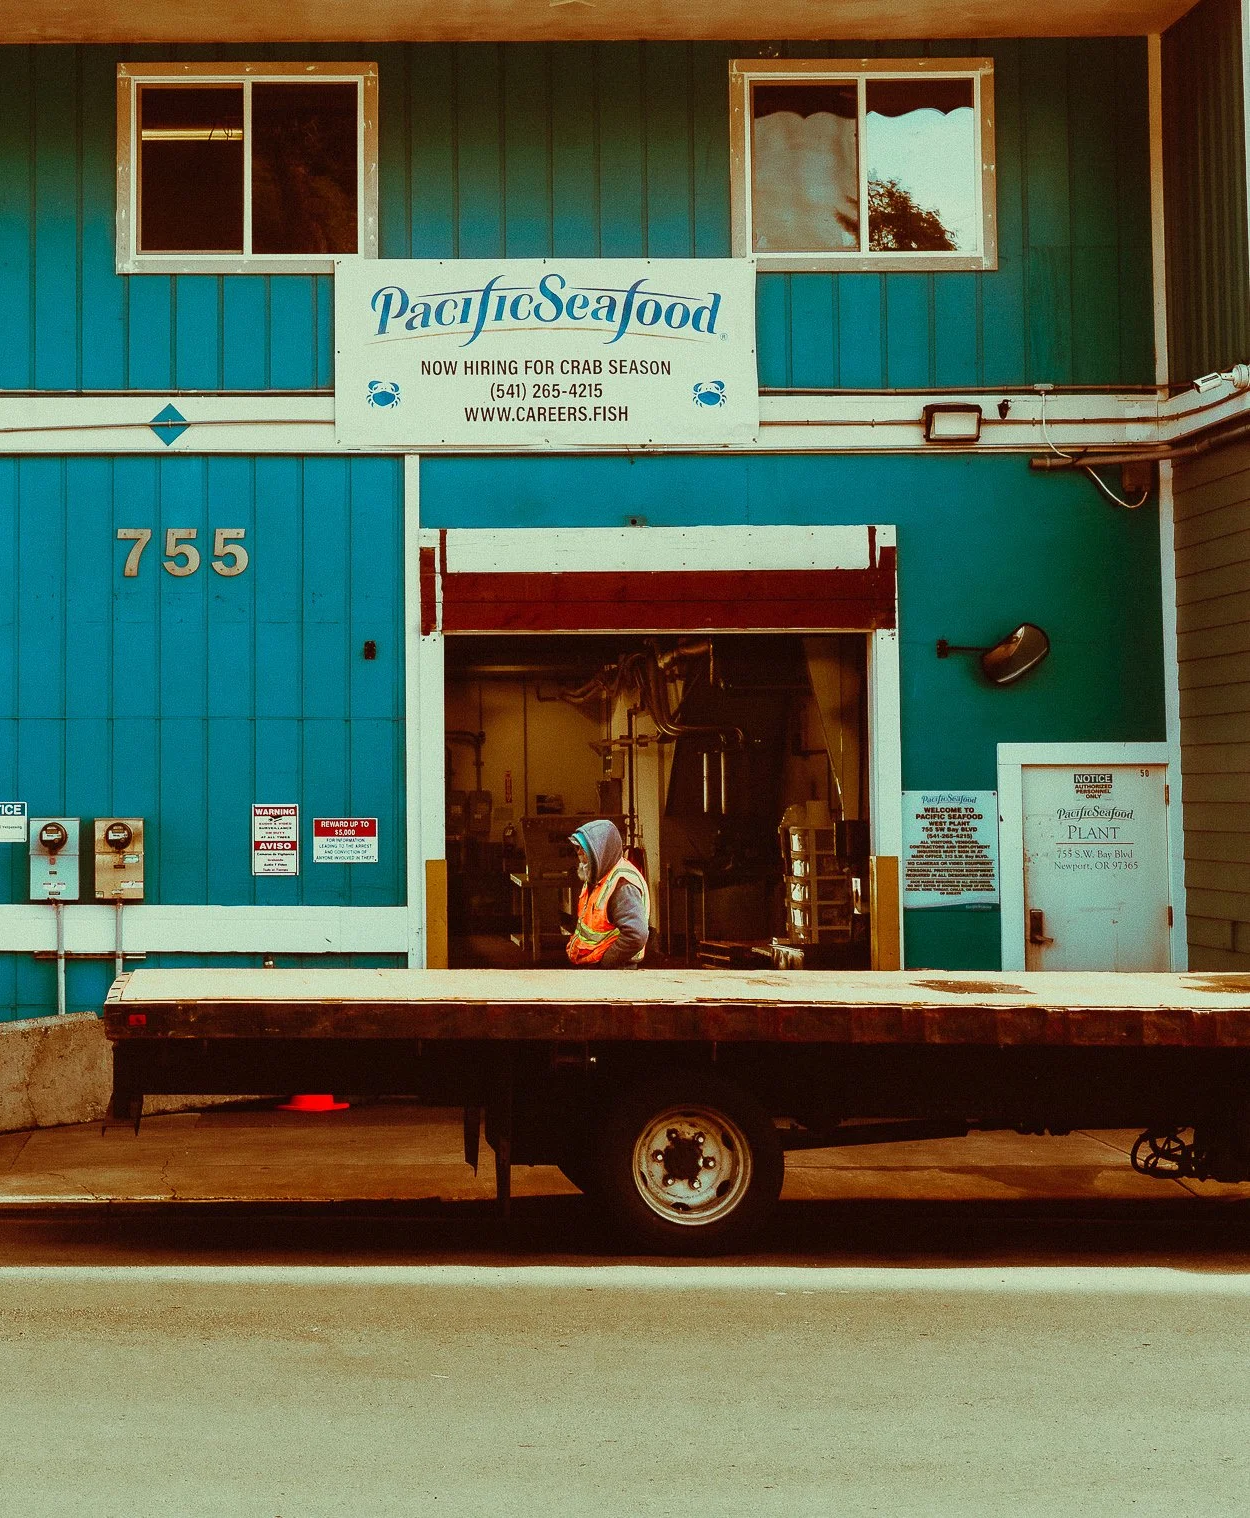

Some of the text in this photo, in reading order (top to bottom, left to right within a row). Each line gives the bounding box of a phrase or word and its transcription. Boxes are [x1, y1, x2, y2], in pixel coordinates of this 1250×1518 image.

[422, 360, 671, 376] NOW HIRING FOR CRAB SEASON
[490, 383, 602, 400] (541) 265-4215
[465, 406, 628, 422] WWW.CAREERS.FISH
[117, 528, 248, 576] 755
[1097, 850, 1111, 860] Bay
[1115, 850, 1132, 858] Blvd
[1054, 862, 1092, 871] Newport,
